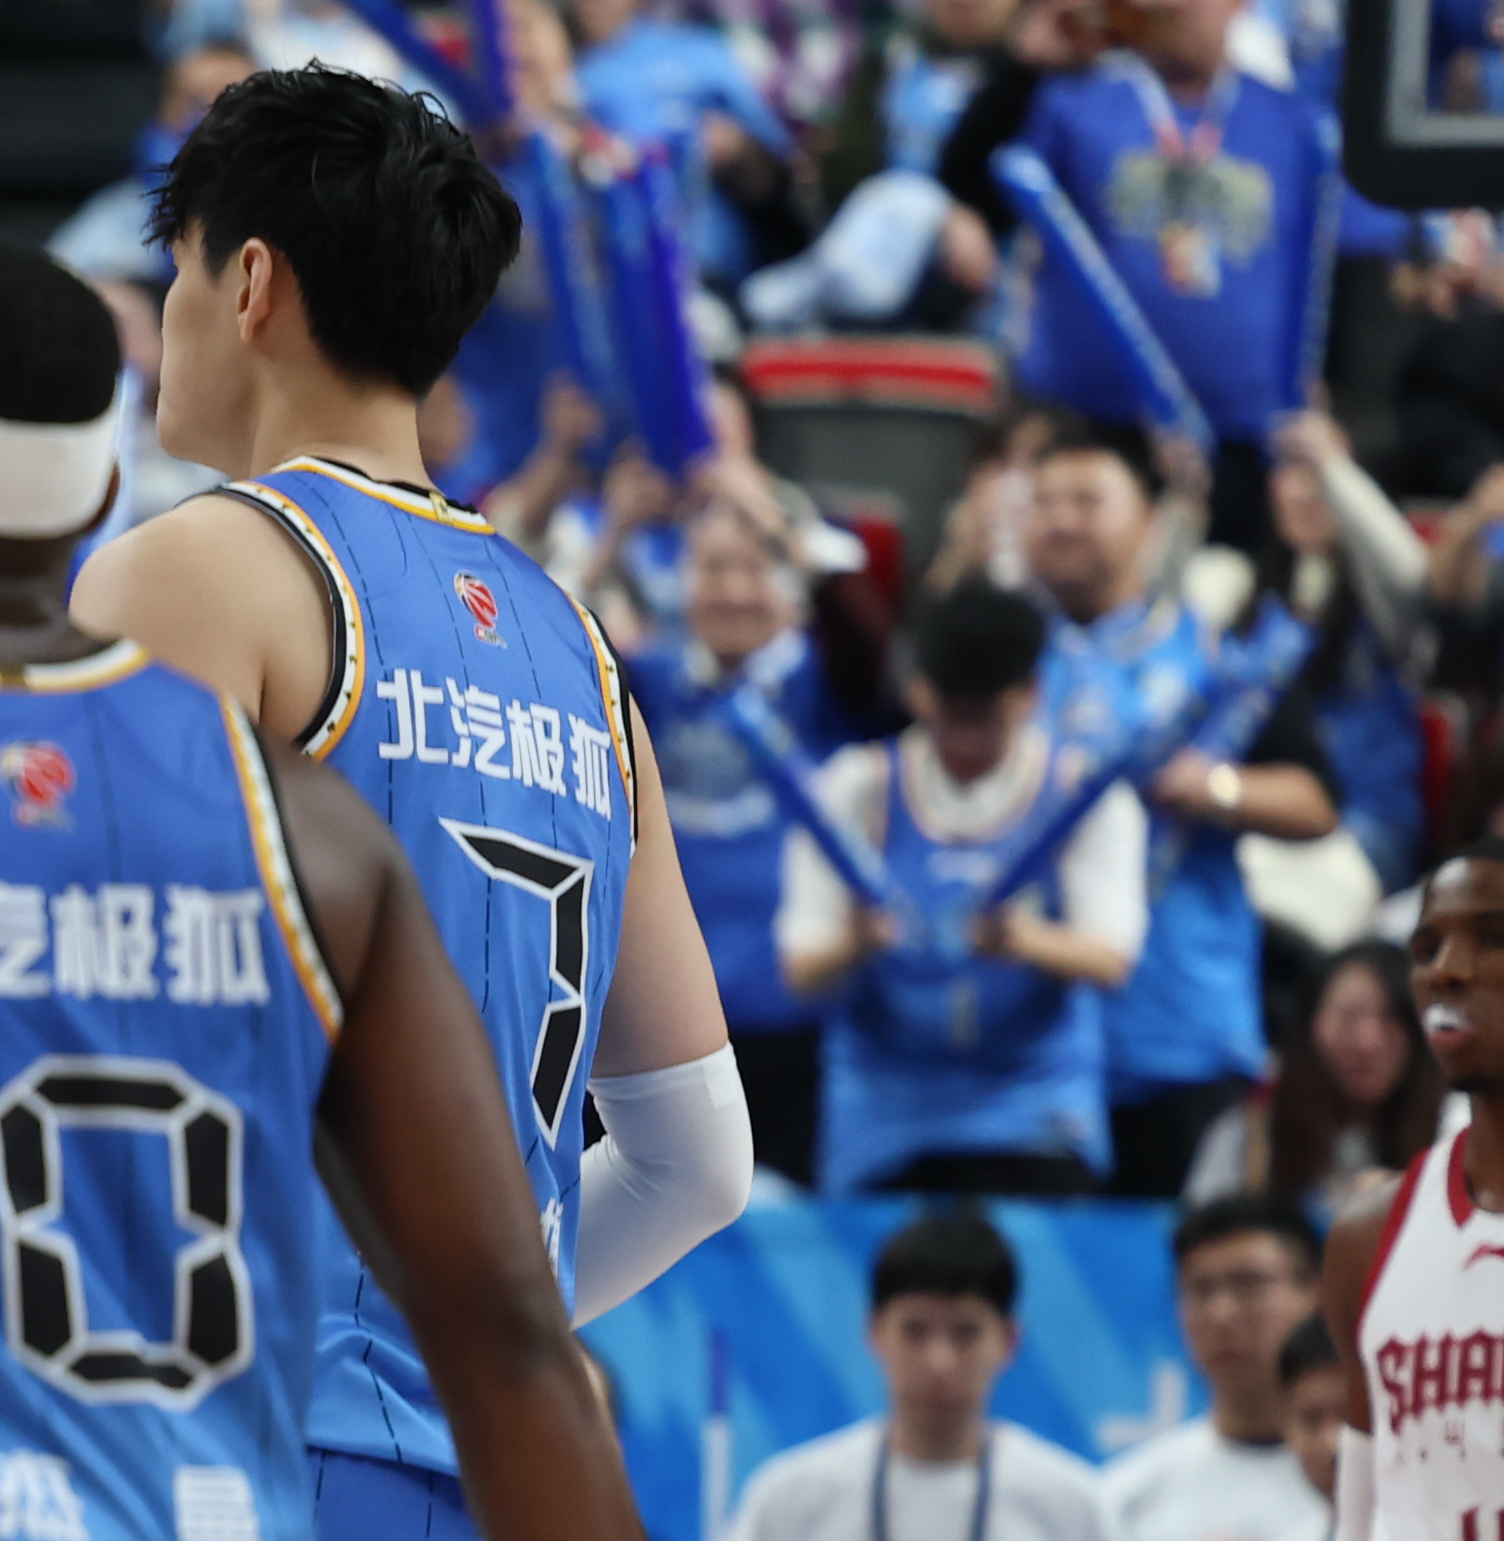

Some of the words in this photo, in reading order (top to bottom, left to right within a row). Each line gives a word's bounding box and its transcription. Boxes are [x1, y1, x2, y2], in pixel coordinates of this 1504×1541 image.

[376, 668, 611, 821] 北汽极狐
[438, 816, 595, 1151] 7
[1376, 1327, 1504, 1437] SHA
